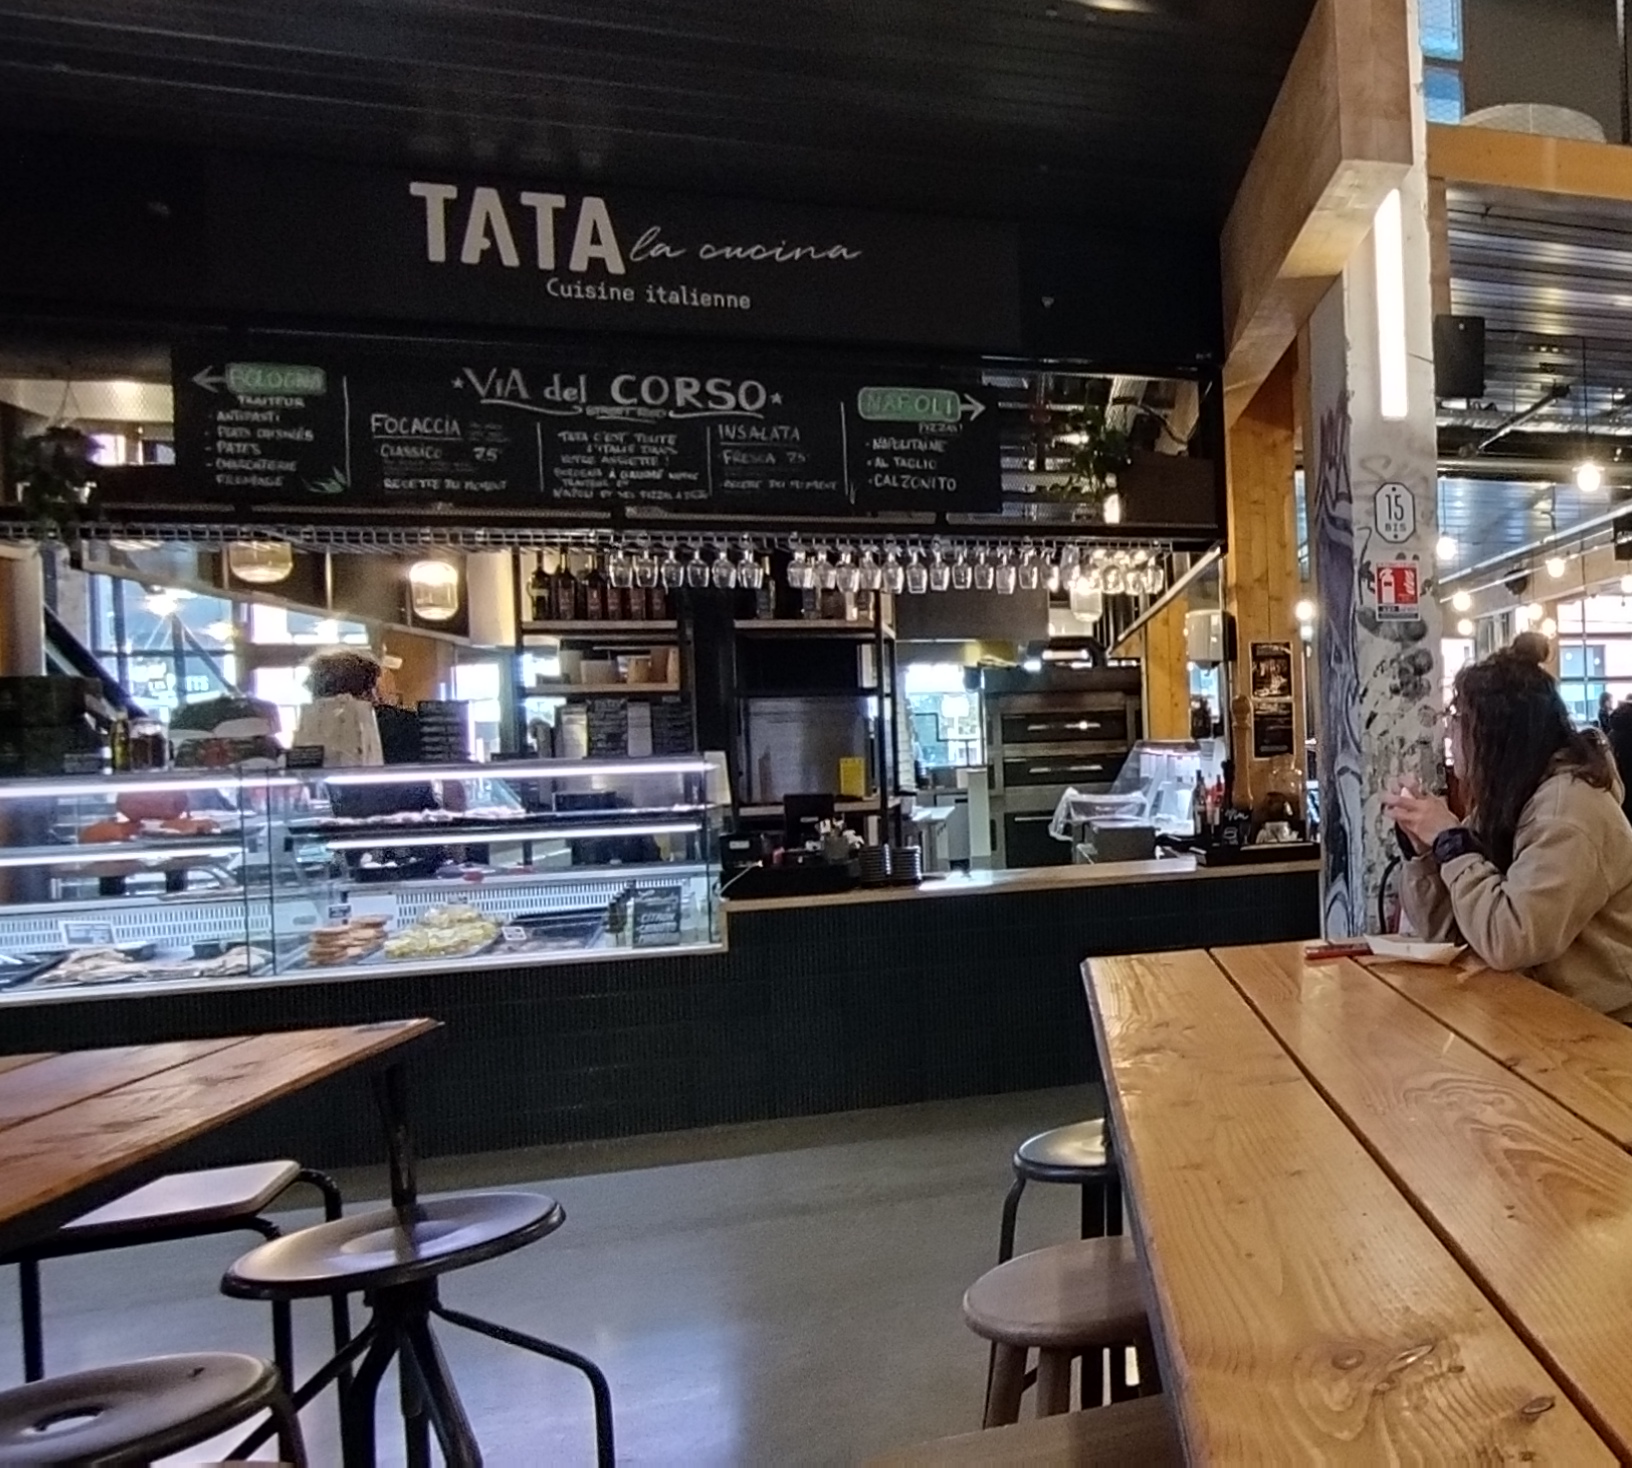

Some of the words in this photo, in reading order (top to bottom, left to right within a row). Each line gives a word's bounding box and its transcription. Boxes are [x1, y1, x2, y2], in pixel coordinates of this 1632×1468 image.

[409, 181, 627, 275] TATA
[629, 225, 686, 262] la
[700, 240, 863, 263] cucina
[546, 277, 635, 302] Cuisine
[646, 280, 751, 310] italienne
[543, 373, 587, 403] del
[611, 374, 767, 411] CORSO
[866, 394, 952, 415] NAPOLI
[371, 412, 462, 436] FOCACCIA
[718, 423, 800, 441] INSALATA
[1384, 493, 1405, 521] 15
[1384, 522, 1407, 533] BIS
